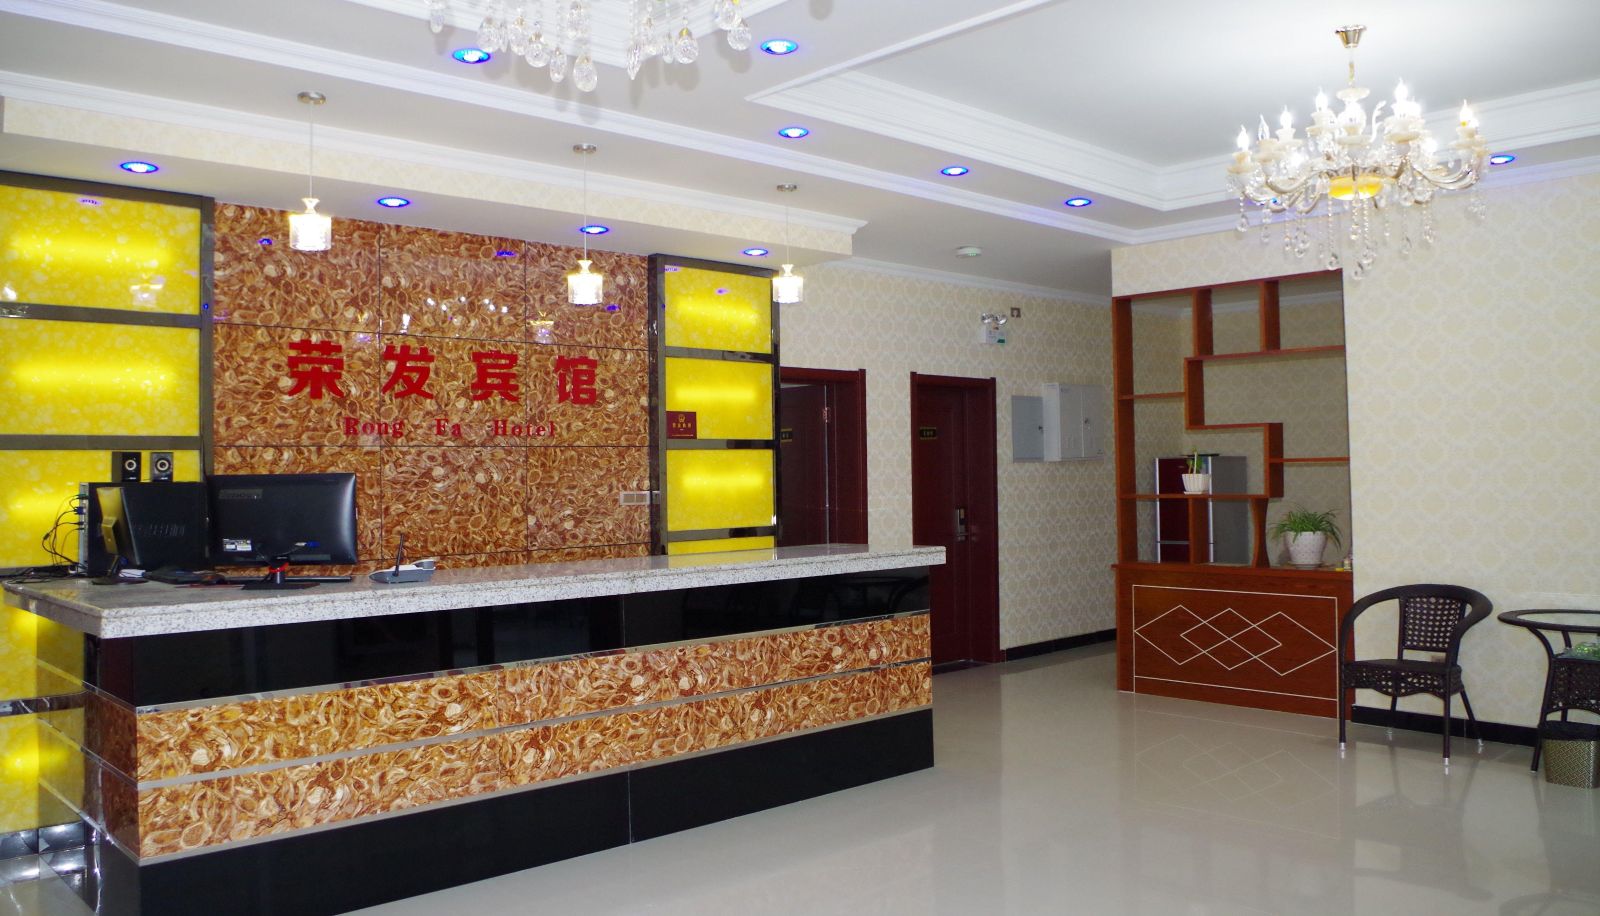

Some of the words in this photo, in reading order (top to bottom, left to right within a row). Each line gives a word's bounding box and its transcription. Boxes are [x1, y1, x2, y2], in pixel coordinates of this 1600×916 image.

[287, 339, 598, 405] 荣发宾馆
[343, 416, 404, 438] Rong
[434, 418, 462, 437] Fa
[493, 419, 556, 437] Hotel
